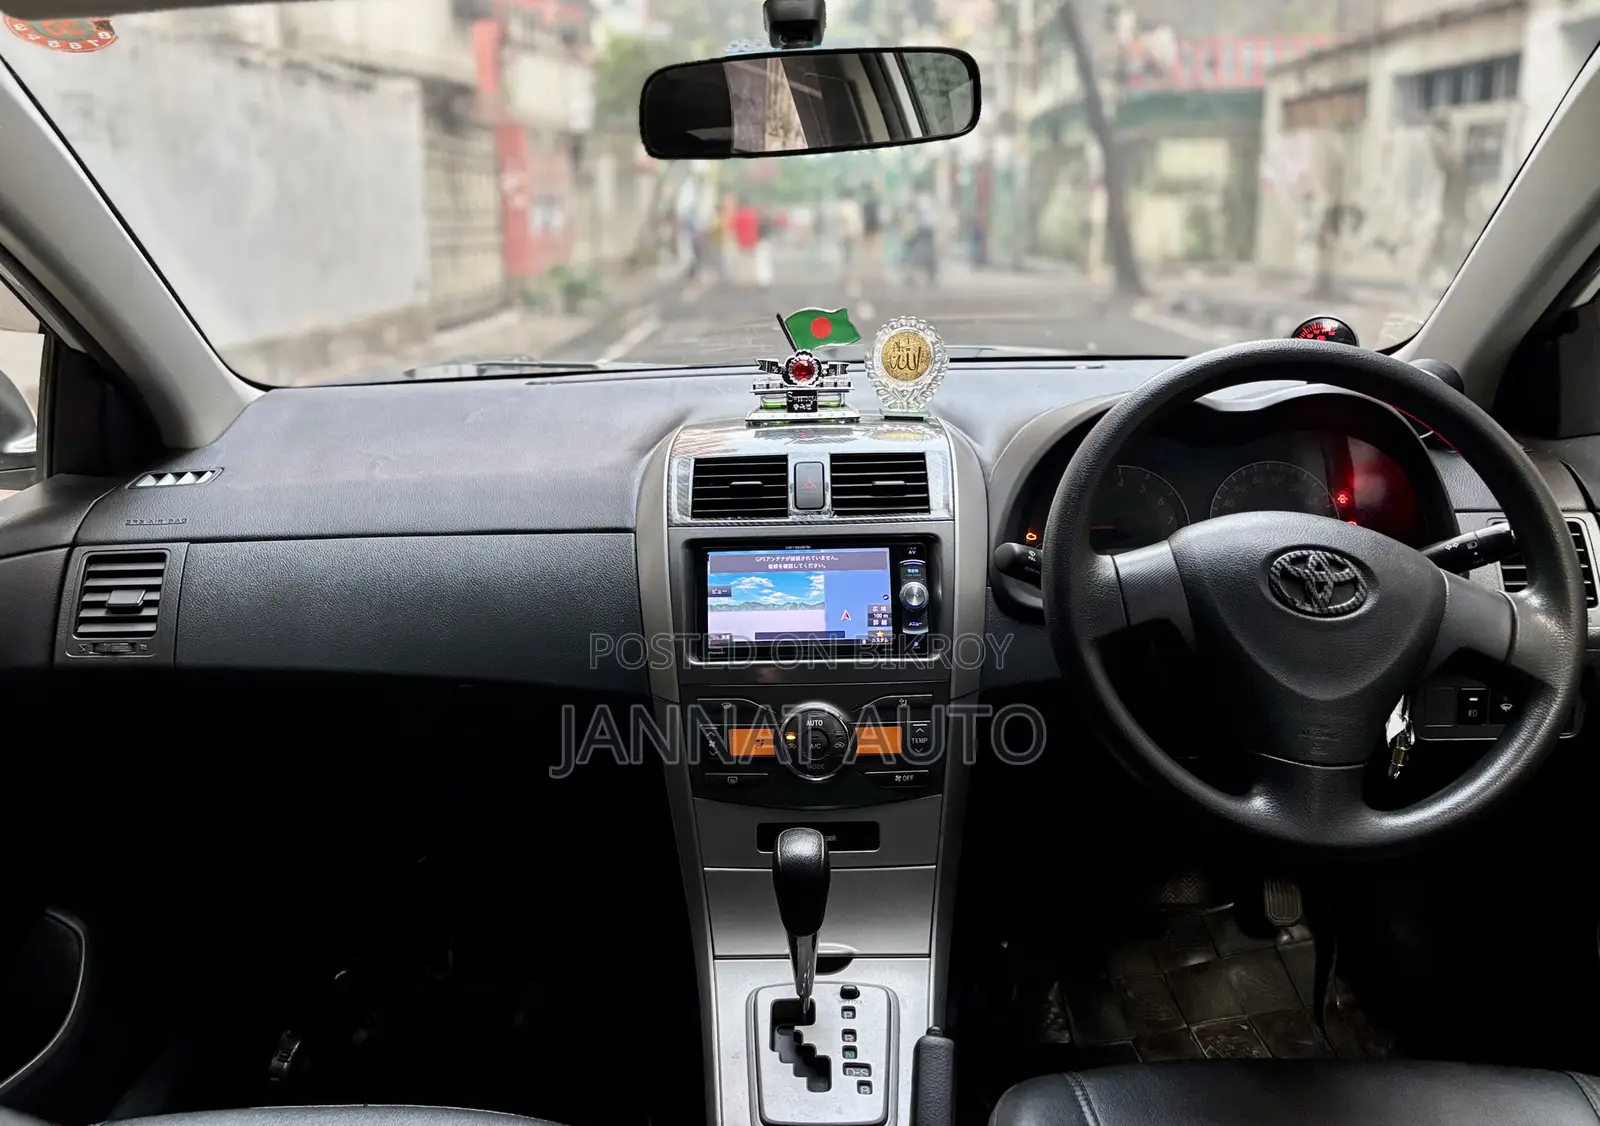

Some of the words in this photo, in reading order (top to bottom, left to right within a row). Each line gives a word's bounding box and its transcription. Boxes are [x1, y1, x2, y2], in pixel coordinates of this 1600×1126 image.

[1157, 496, 1165, 506] 6
[1167, 516, 1174, 525] 7
[805, 719, 824, 727] AUTO
[902, 774, 914, 782] OFF
[843, 1010, 854, 1019] P
[843, 1034, 855, 1042] R
[844, 1050, 855, 1059] N
